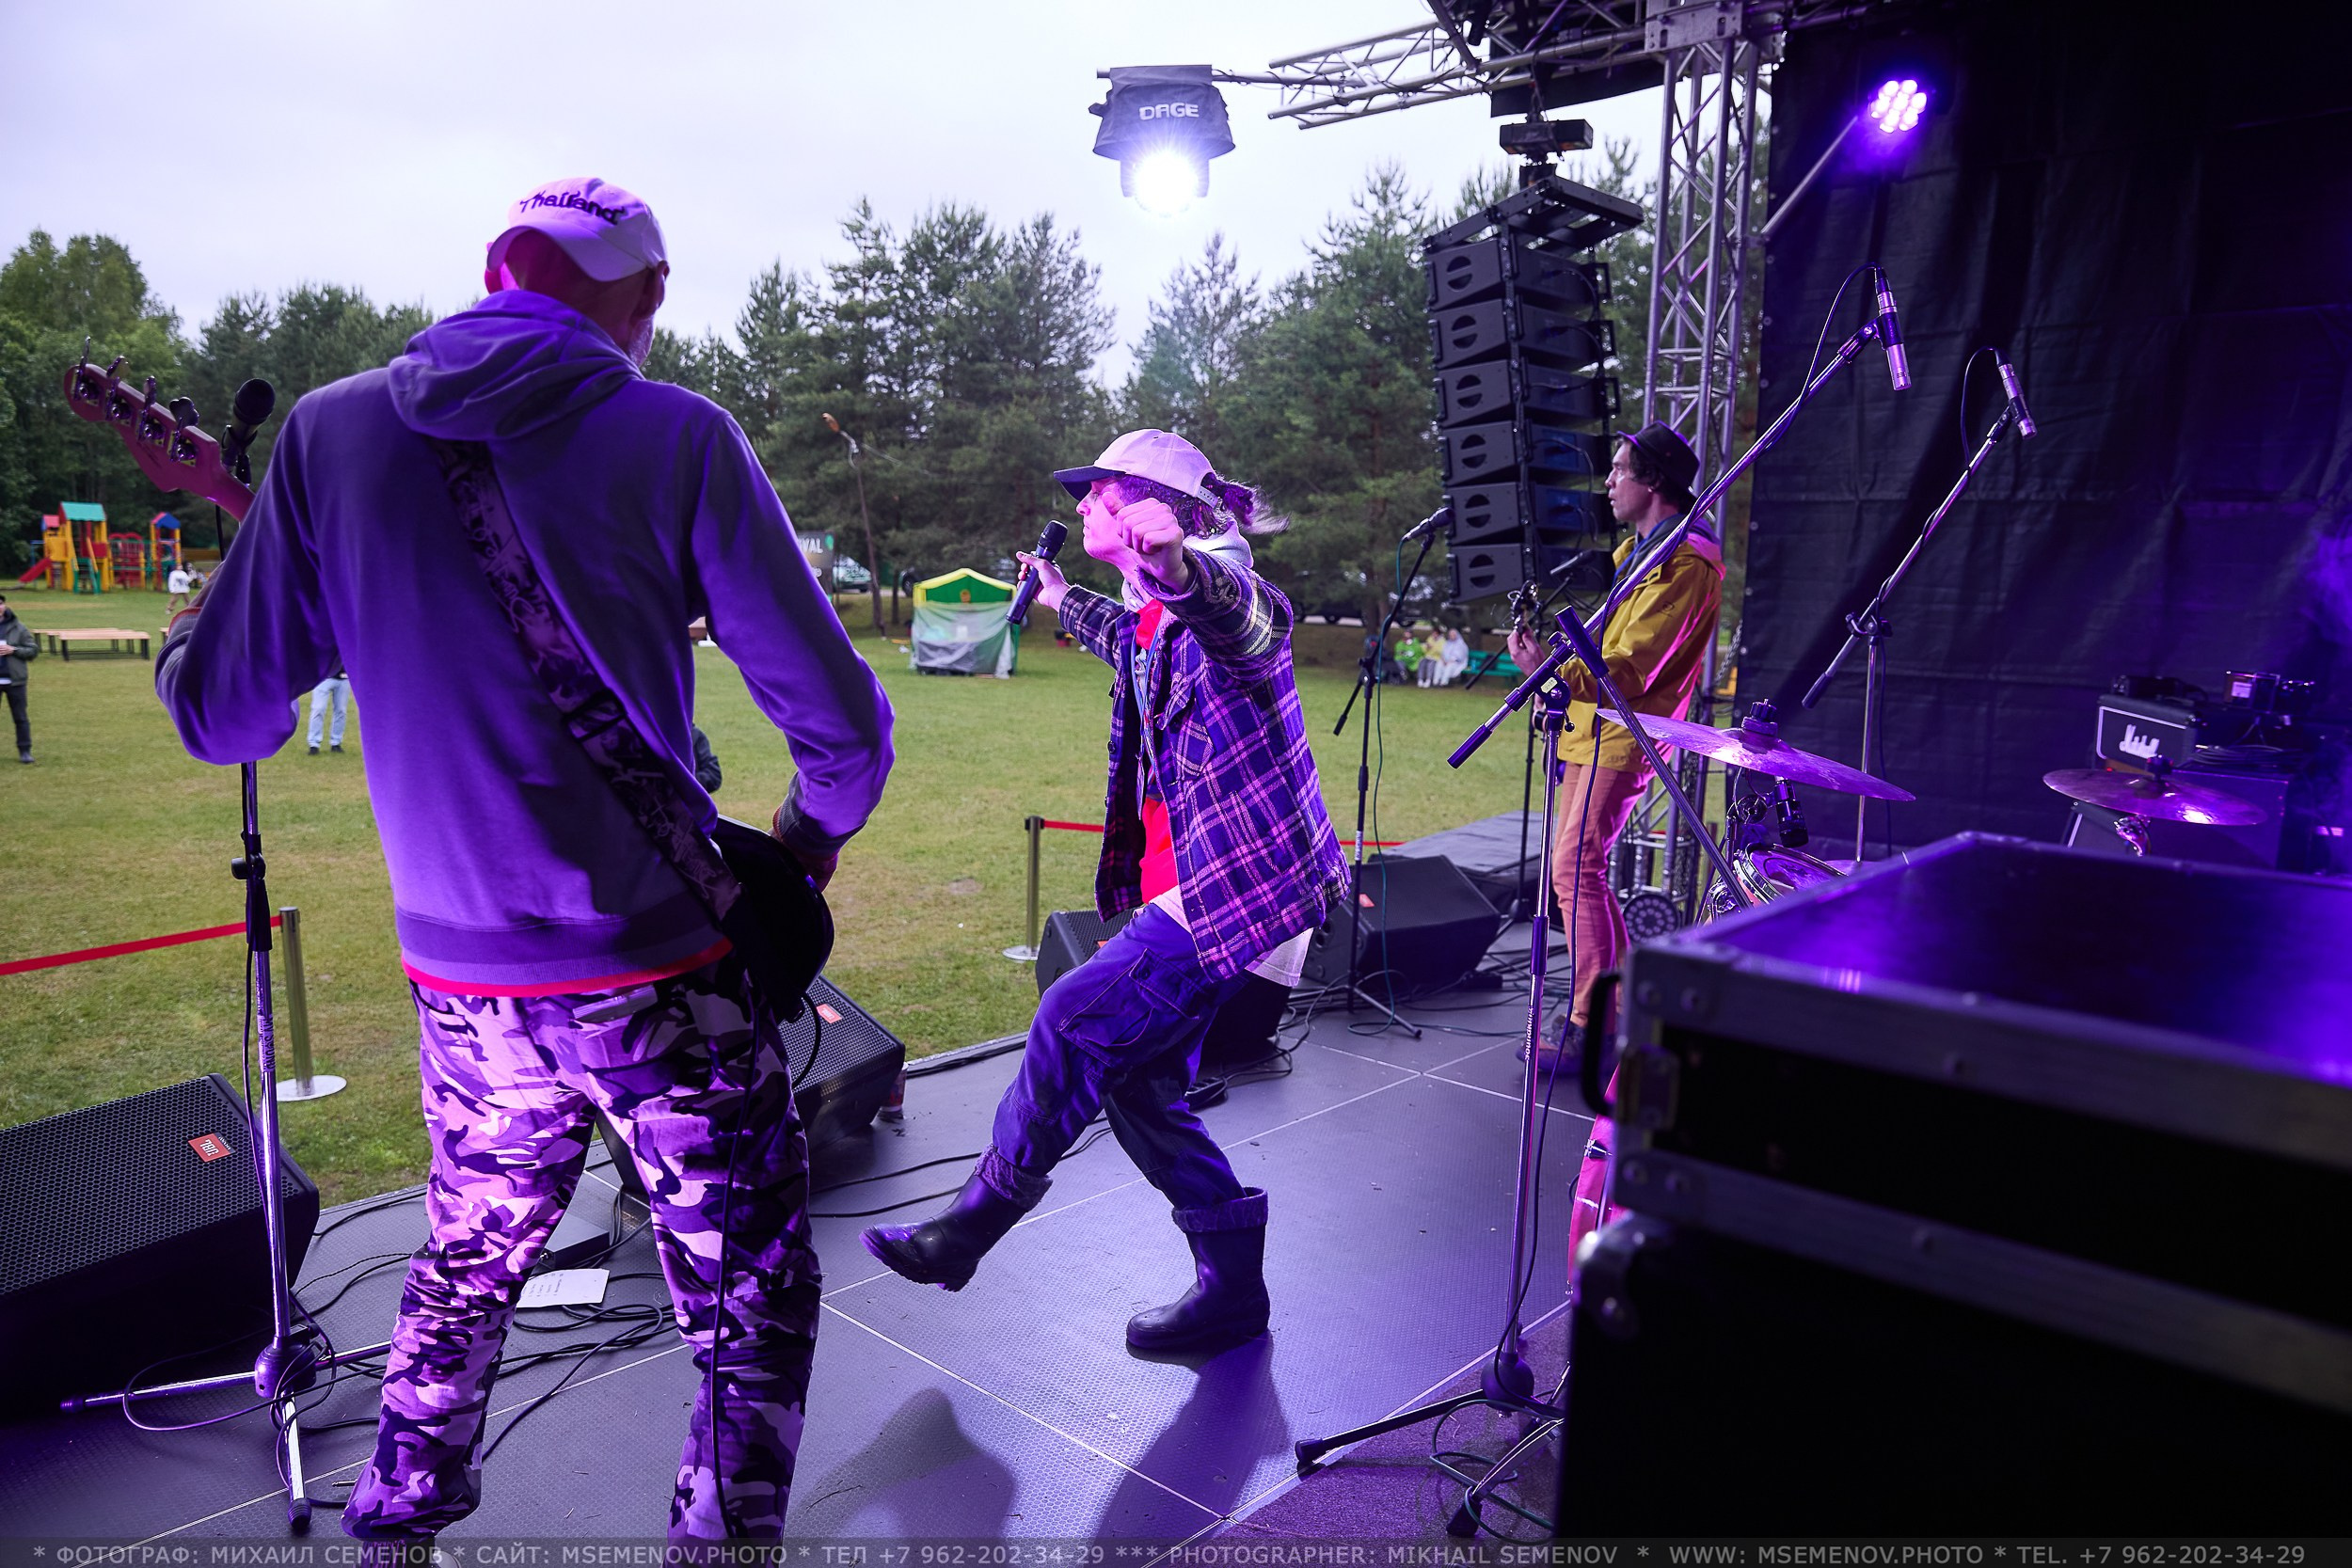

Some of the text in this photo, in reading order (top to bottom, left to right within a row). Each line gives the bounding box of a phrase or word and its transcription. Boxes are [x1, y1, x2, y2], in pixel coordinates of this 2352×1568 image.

[1139, 102, 1200, 120] DAGE
[519, 190, 626, 226] Thailand
[199, 1139, 219, 1157] JBL
